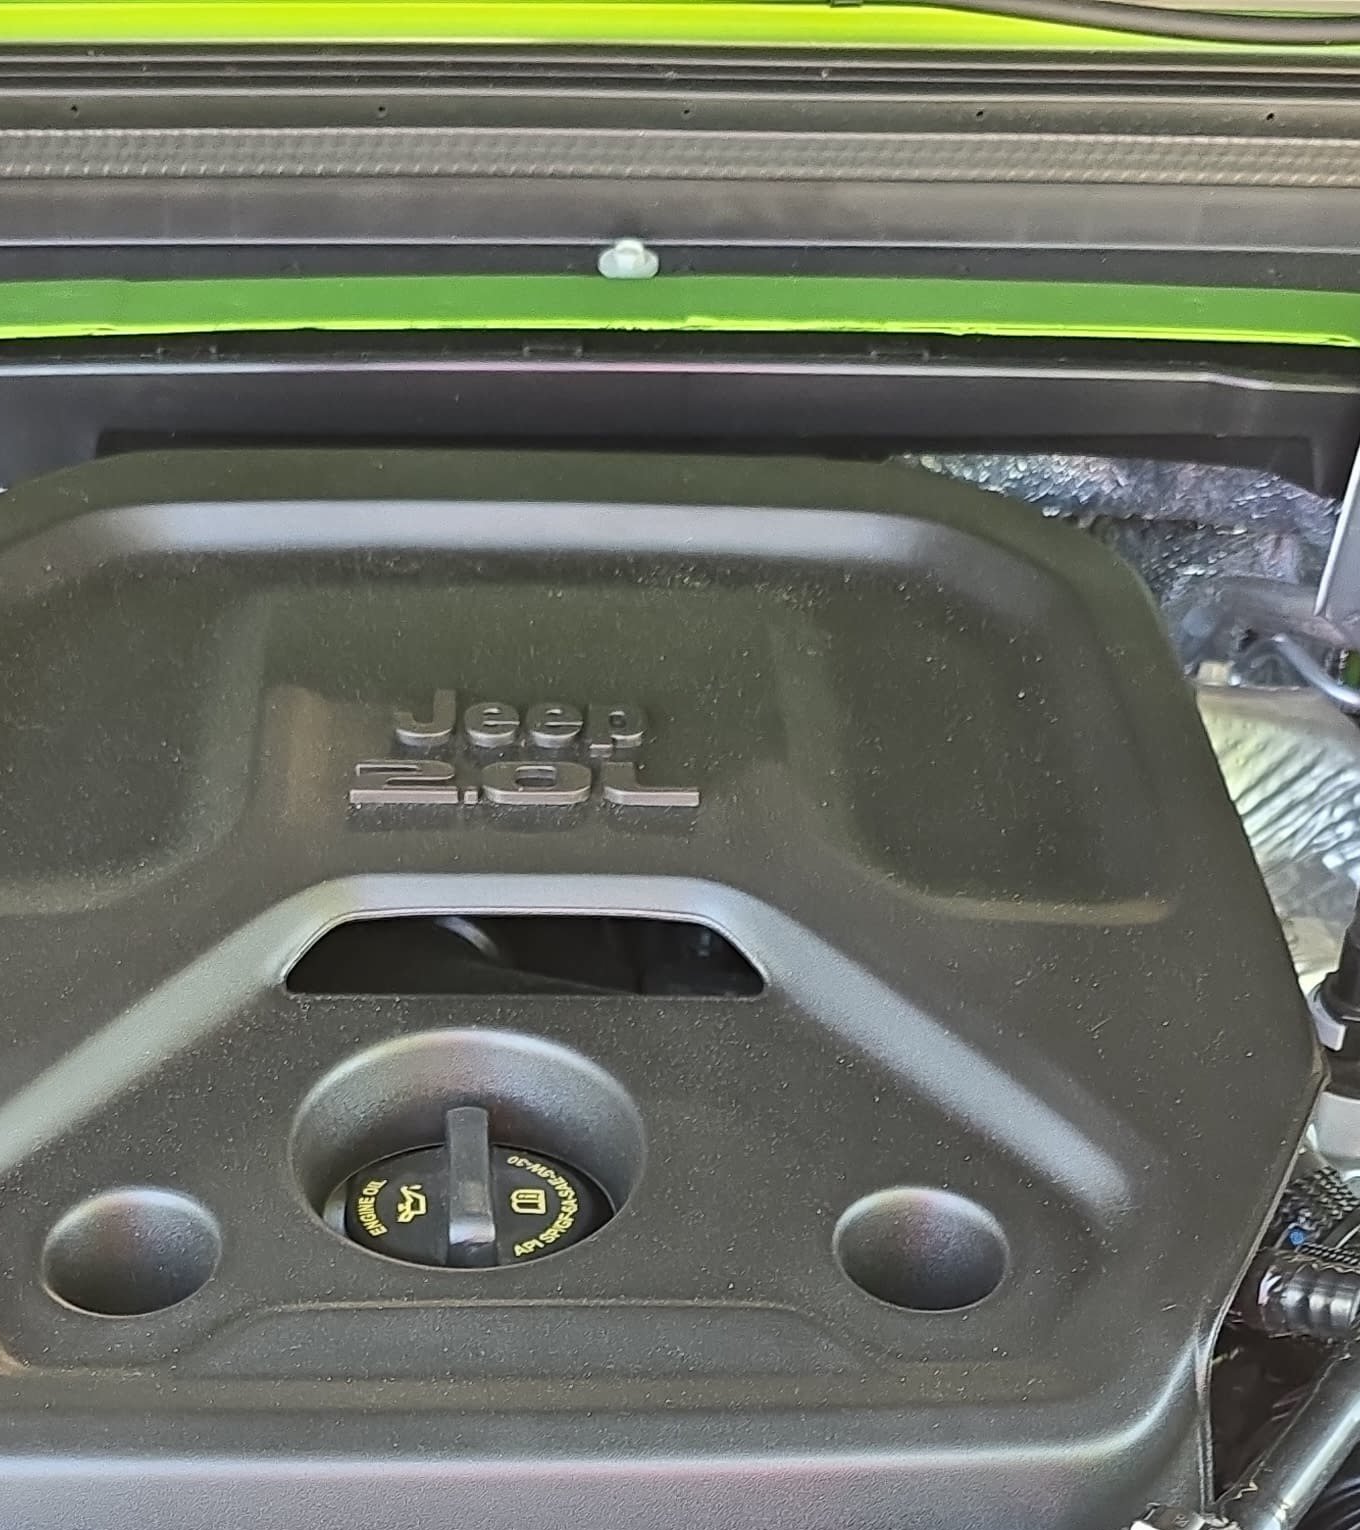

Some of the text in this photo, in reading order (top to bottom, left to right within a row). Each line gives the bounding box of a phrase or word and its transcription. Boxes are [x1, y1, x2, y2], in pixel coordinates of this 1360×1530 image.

[394, 689, 647, 758] Jeep
[348, 759, 700, 806] 2.0L
[355, 1178, 389, 1238] ENGINE OIL
[513, 1236, 545, 1257] API
